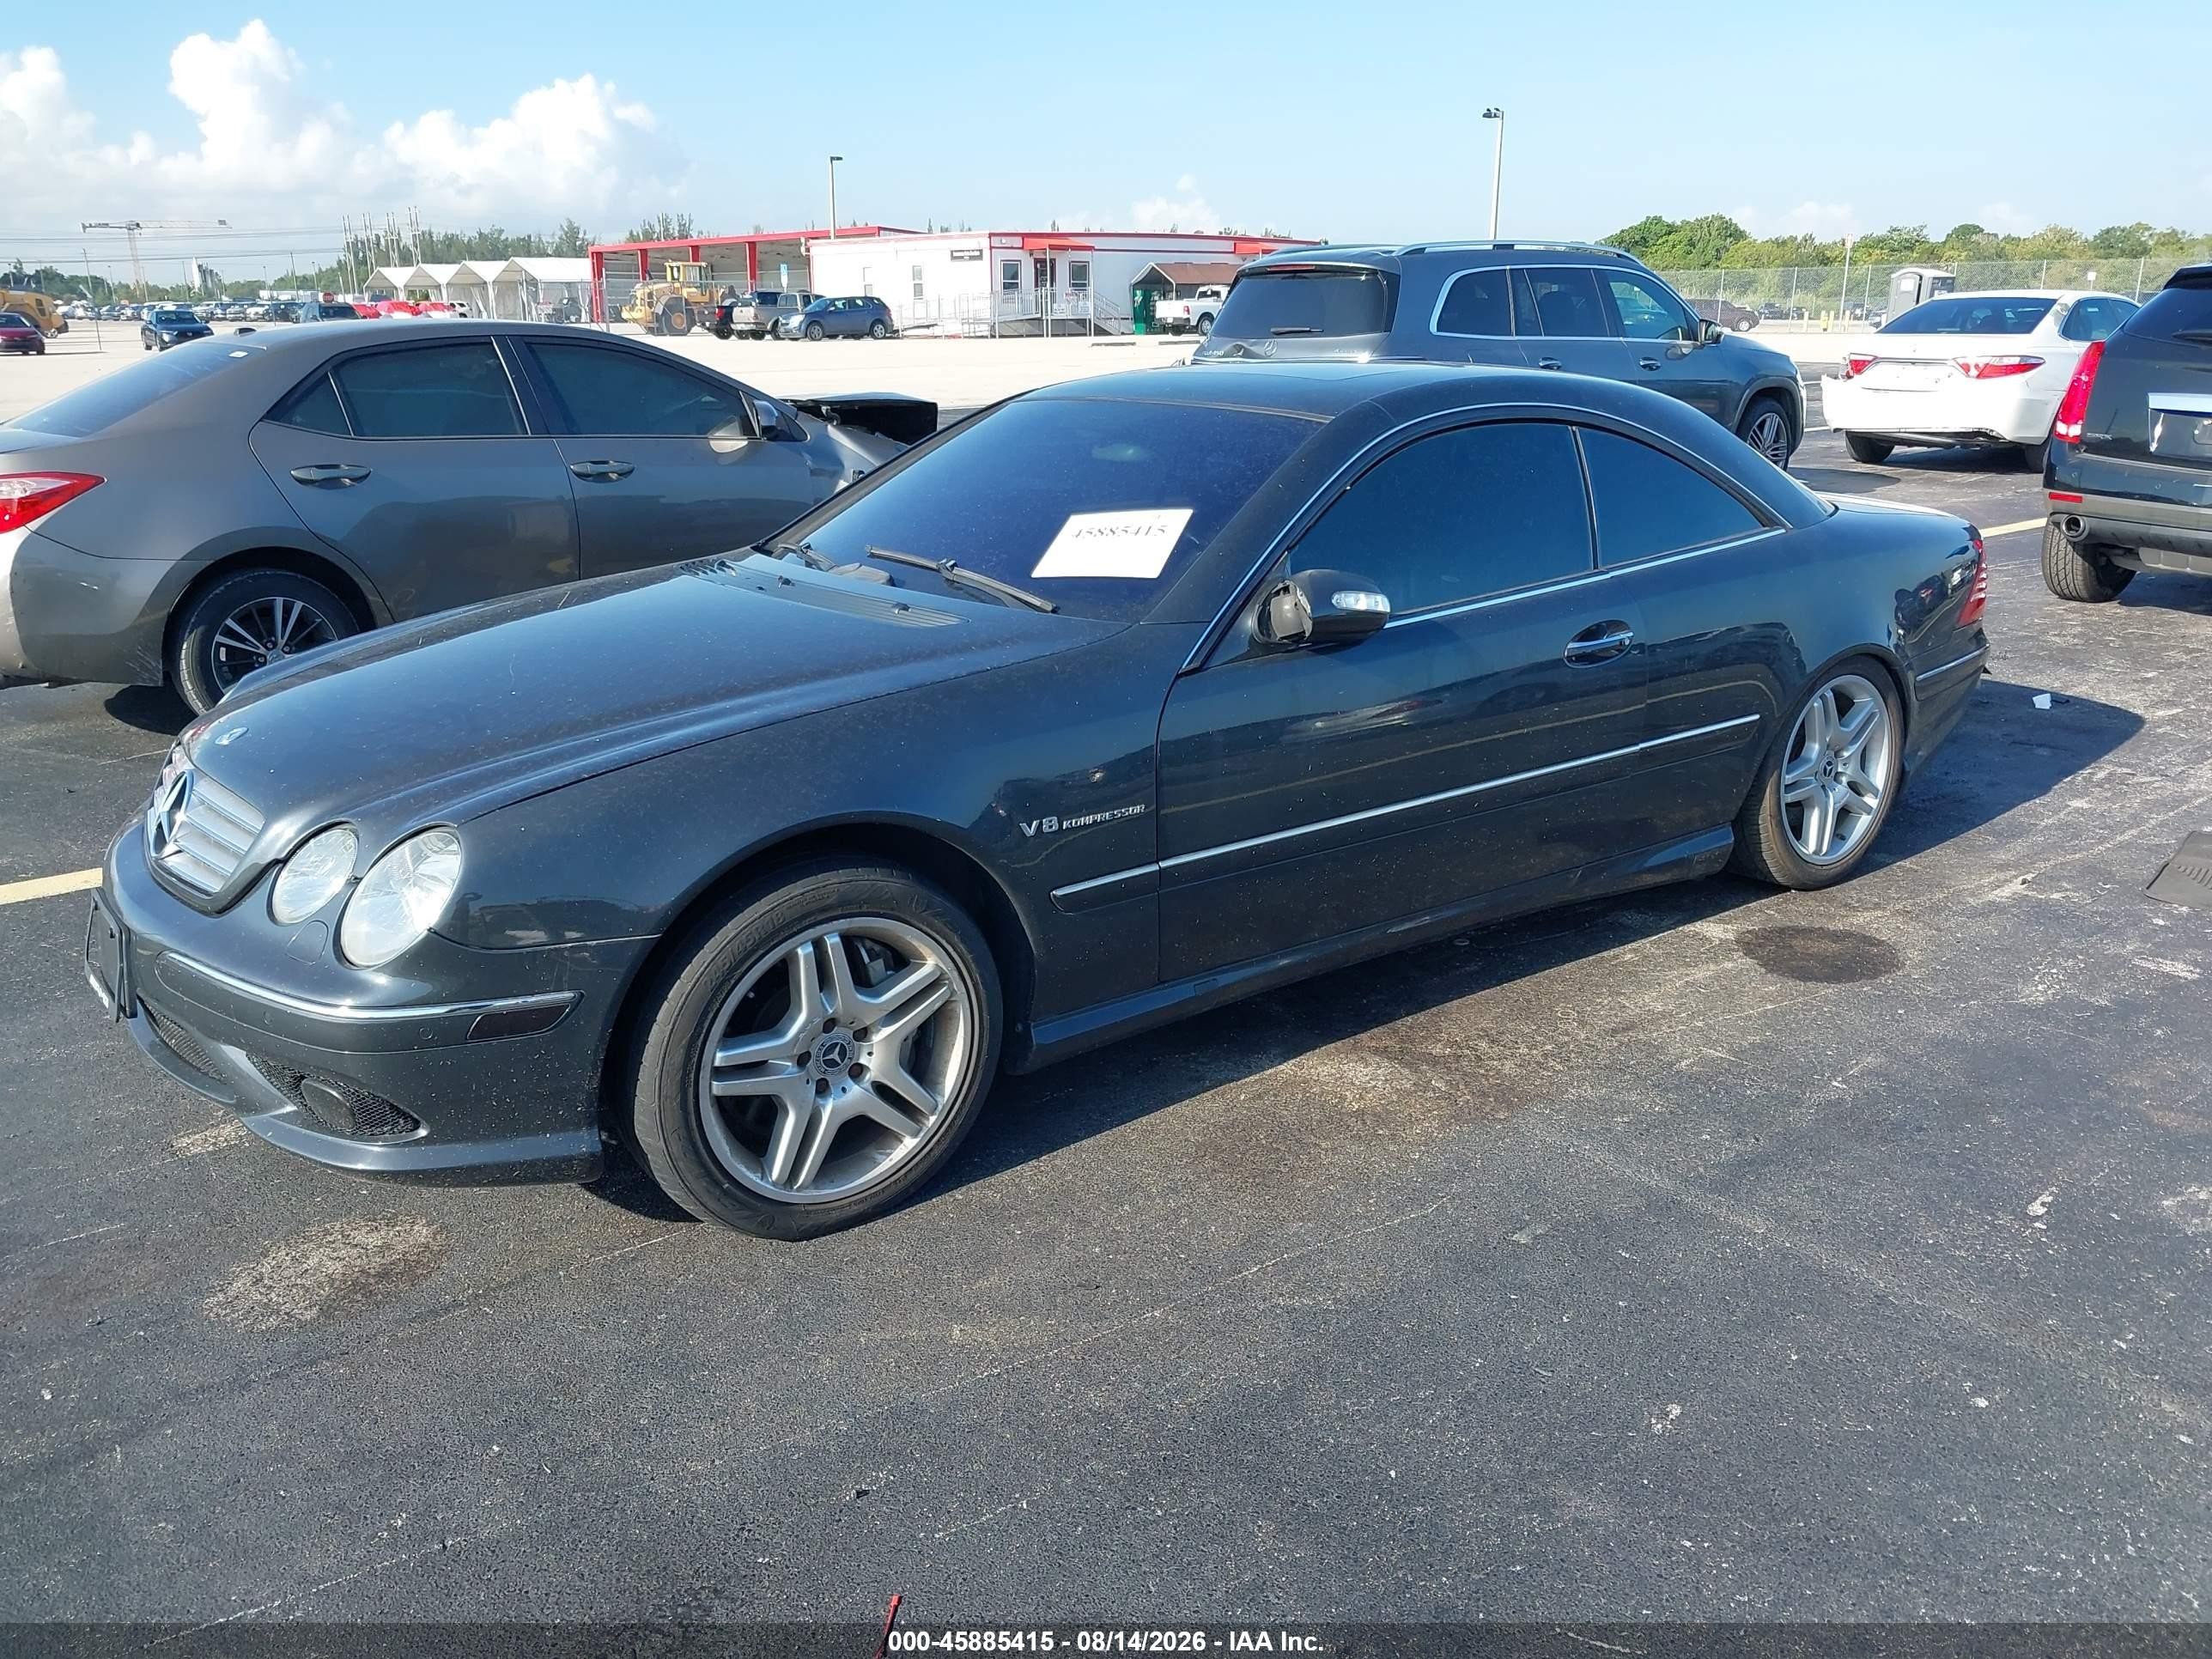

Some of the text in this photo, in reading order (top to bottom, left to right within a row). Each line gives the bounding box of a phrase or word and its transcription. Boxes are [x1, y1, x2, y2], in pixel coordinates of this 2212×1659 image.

[1071, 524, 1169, 538] 45885415
[1019, 804, 1146, 837] V8 KOMPRESSOR
